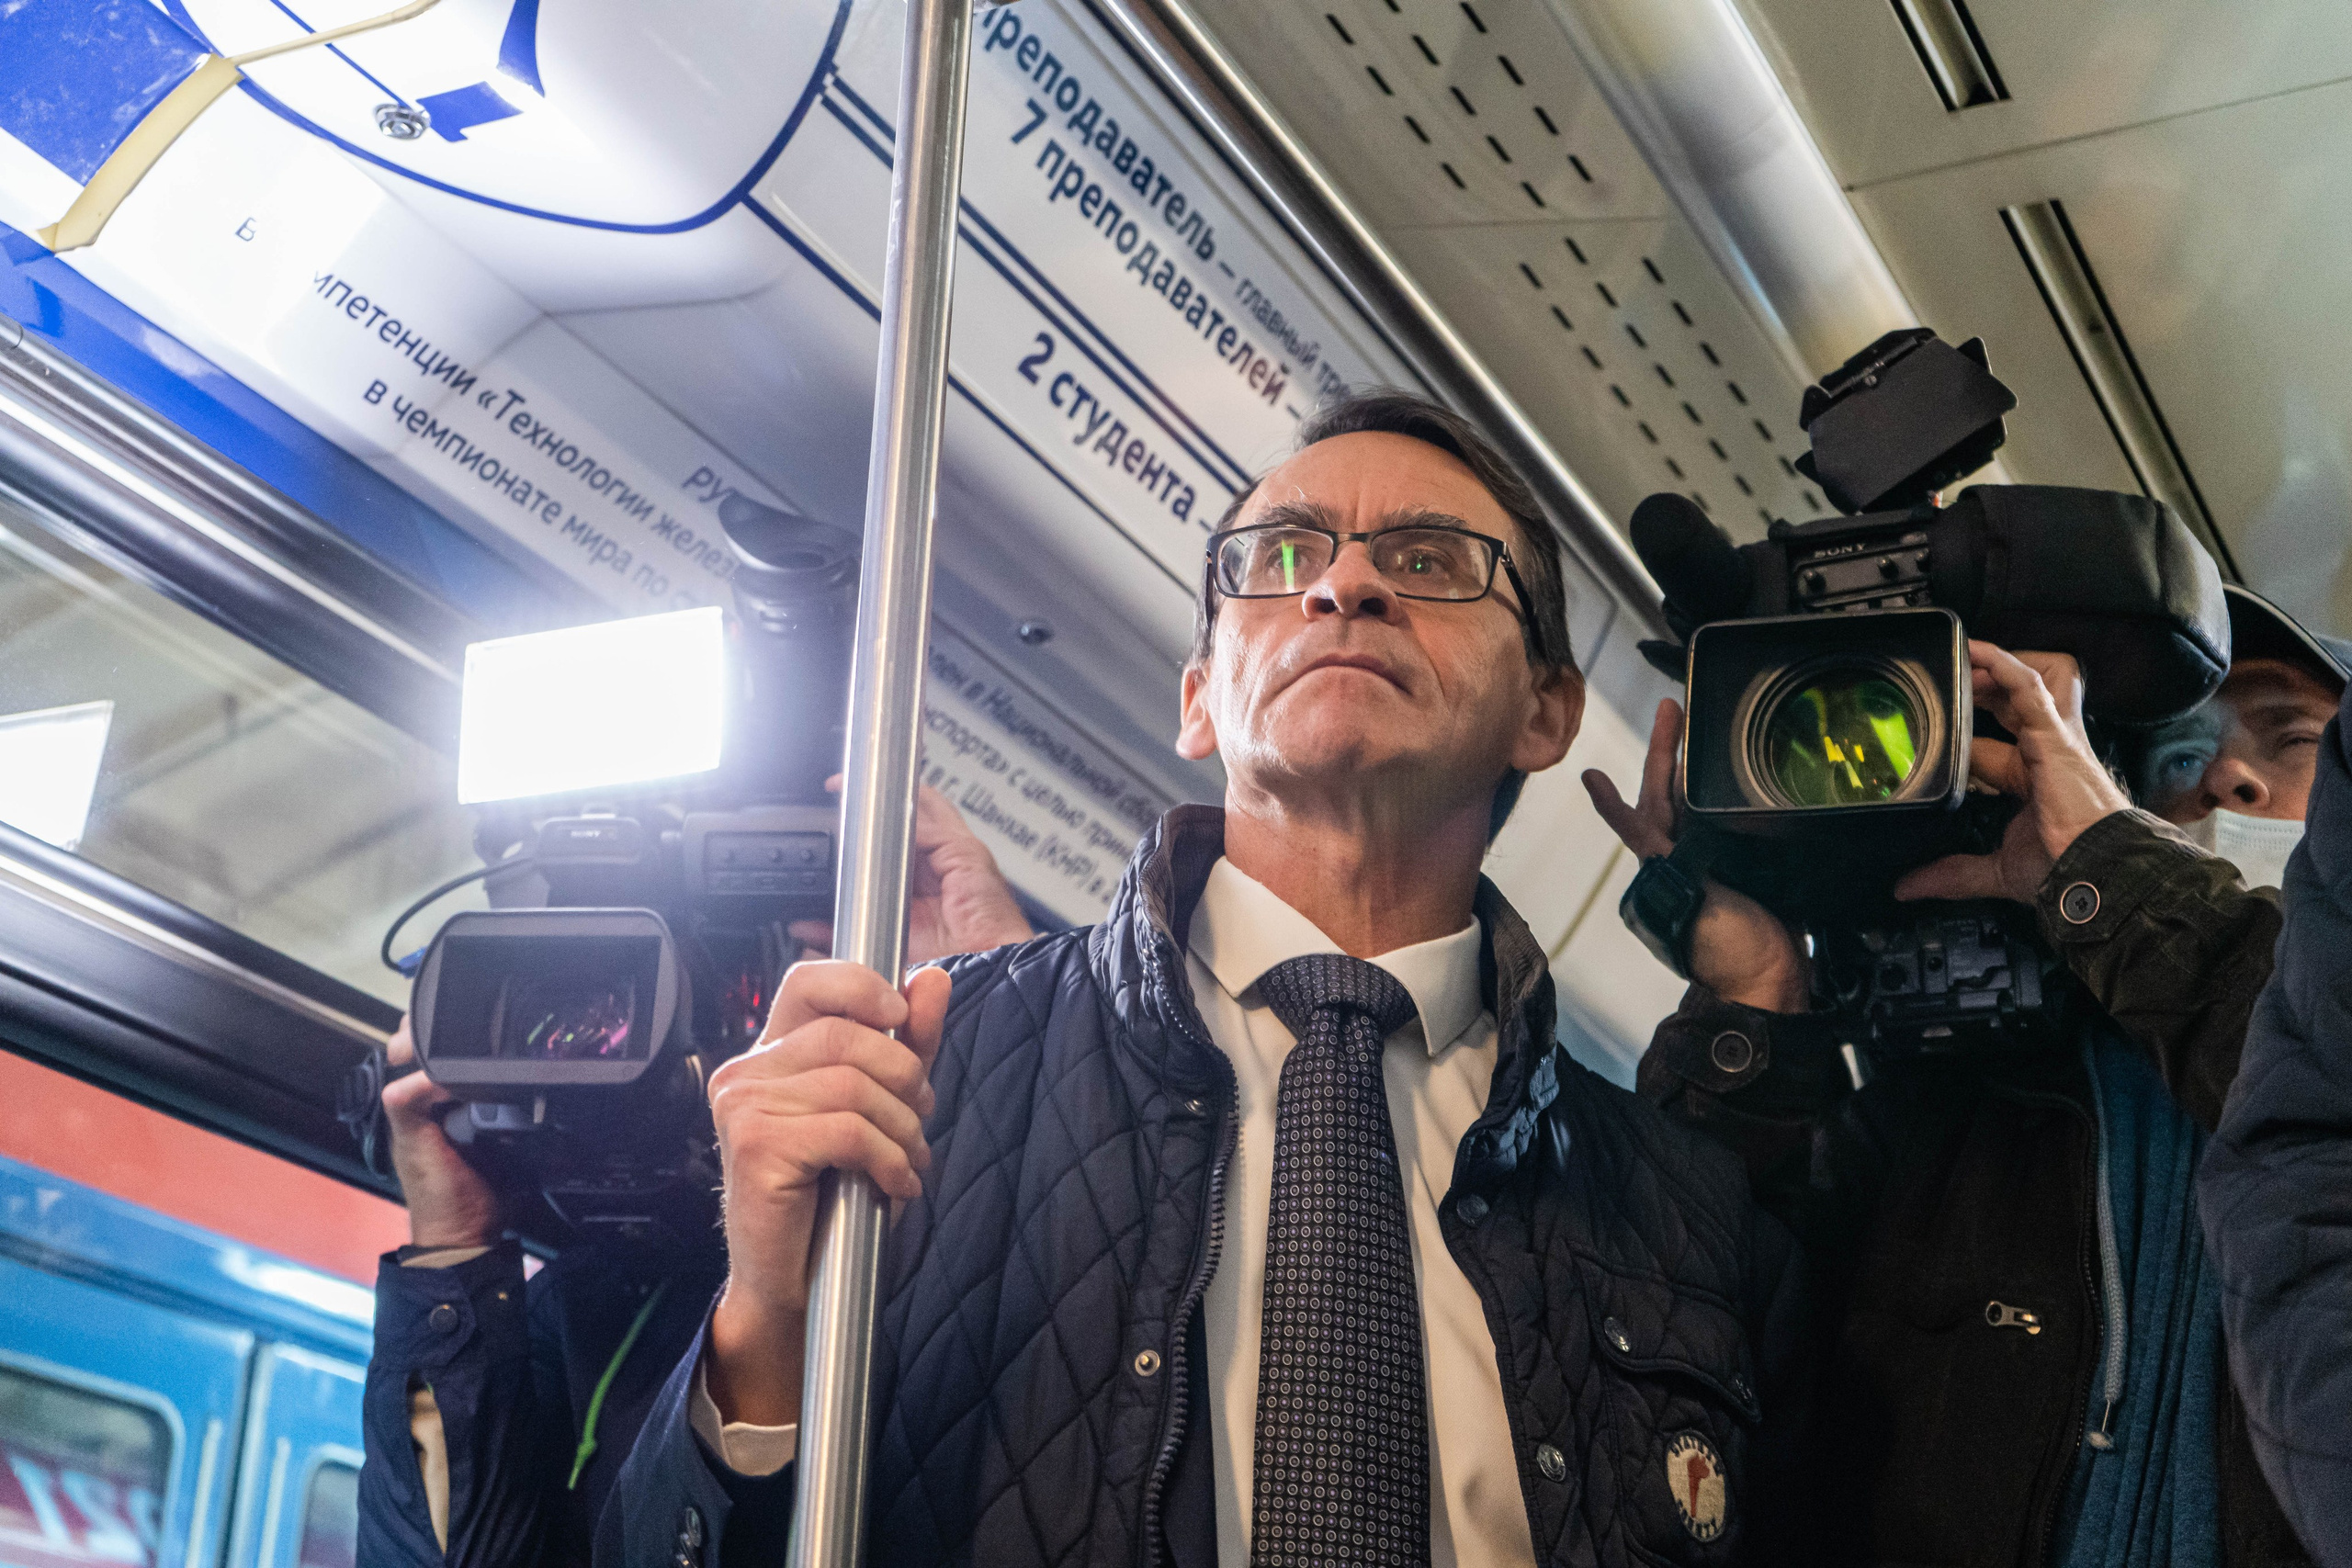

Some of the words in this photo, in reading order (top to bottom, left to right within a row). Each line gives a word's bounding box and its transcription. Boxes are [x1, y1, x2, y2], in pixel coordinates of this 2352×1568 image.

[1010, 98, 1048, 146] 7
[1035, 139, 1291, 408] преподавателей
[1234, 275, 1319, 371] главный
[363, 380, 390, 405] в
[391, 394, 562, 525] чемпионате
[560, 516, 633, 575] мира
[478, 389, 655, 522] «Технологии
[1017, 332, 1057, 385] 2
[1048, 370, 1196, 522] студента
[1815, 543, 1866, 558] SONY
